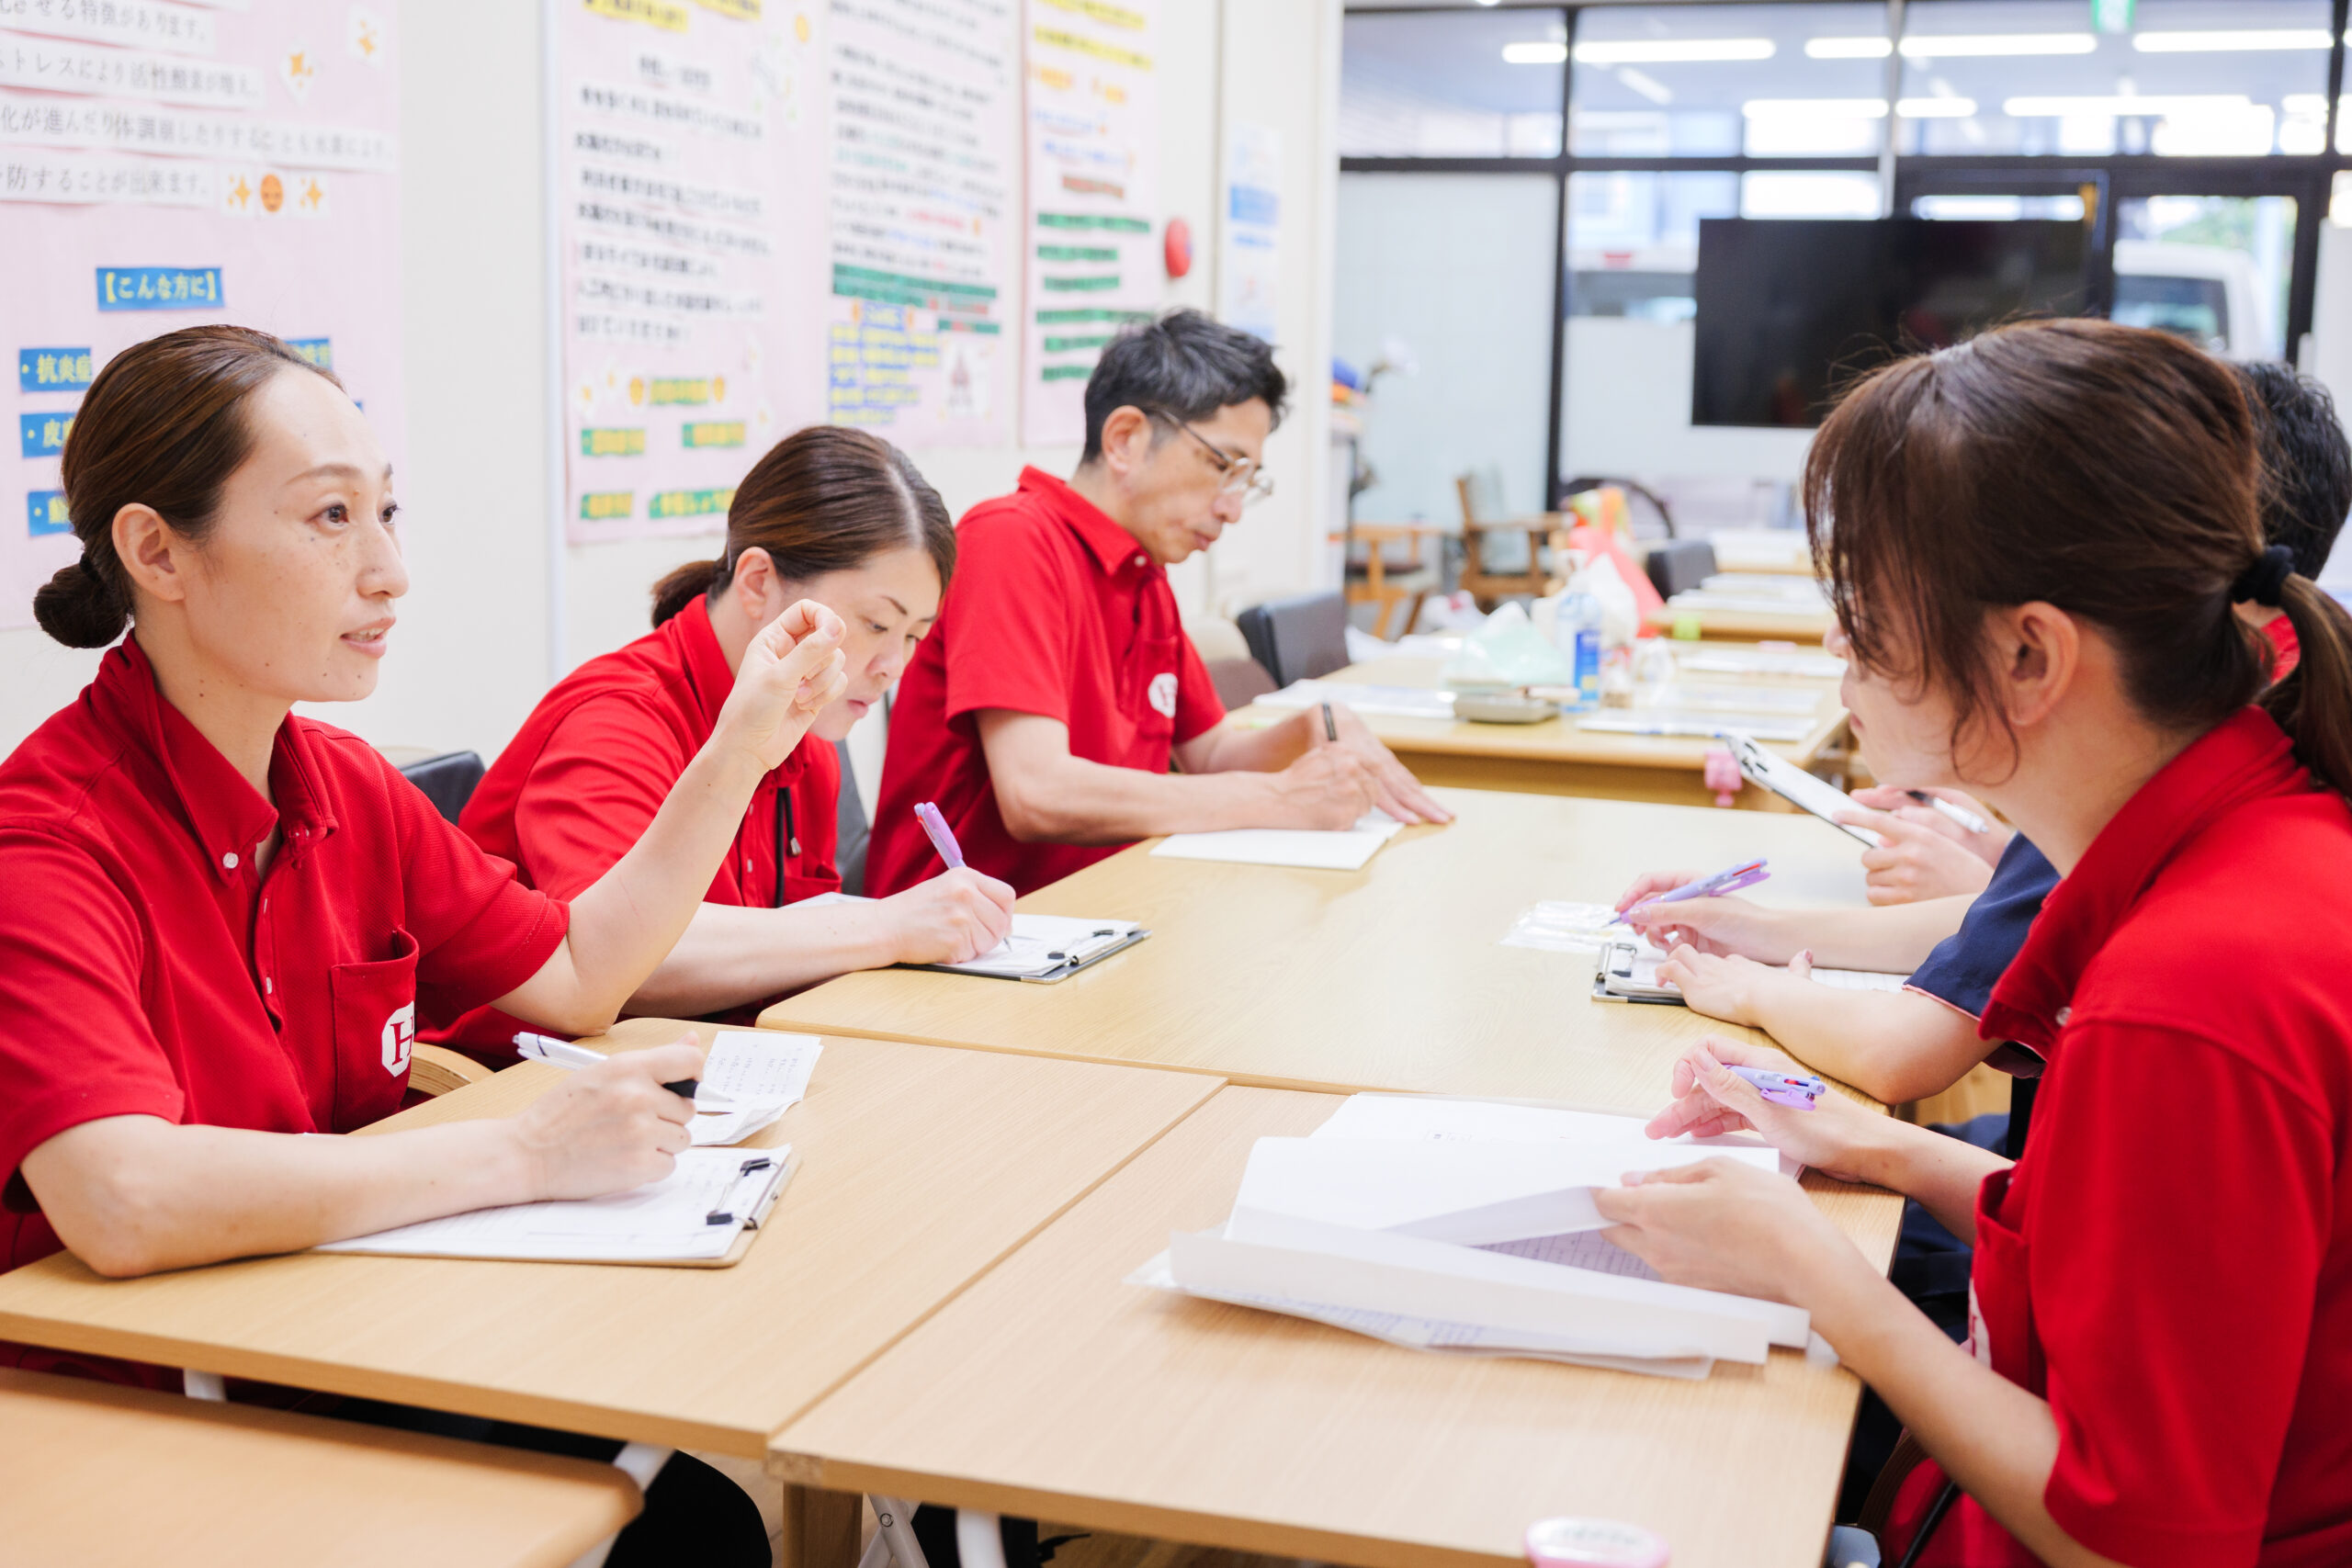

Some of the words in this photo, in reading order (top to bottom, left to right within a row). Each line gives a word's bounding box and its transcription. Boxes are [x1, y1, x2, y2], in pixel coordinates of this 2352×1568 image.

[0, 162, 208, 196] 防することが出来ます。
